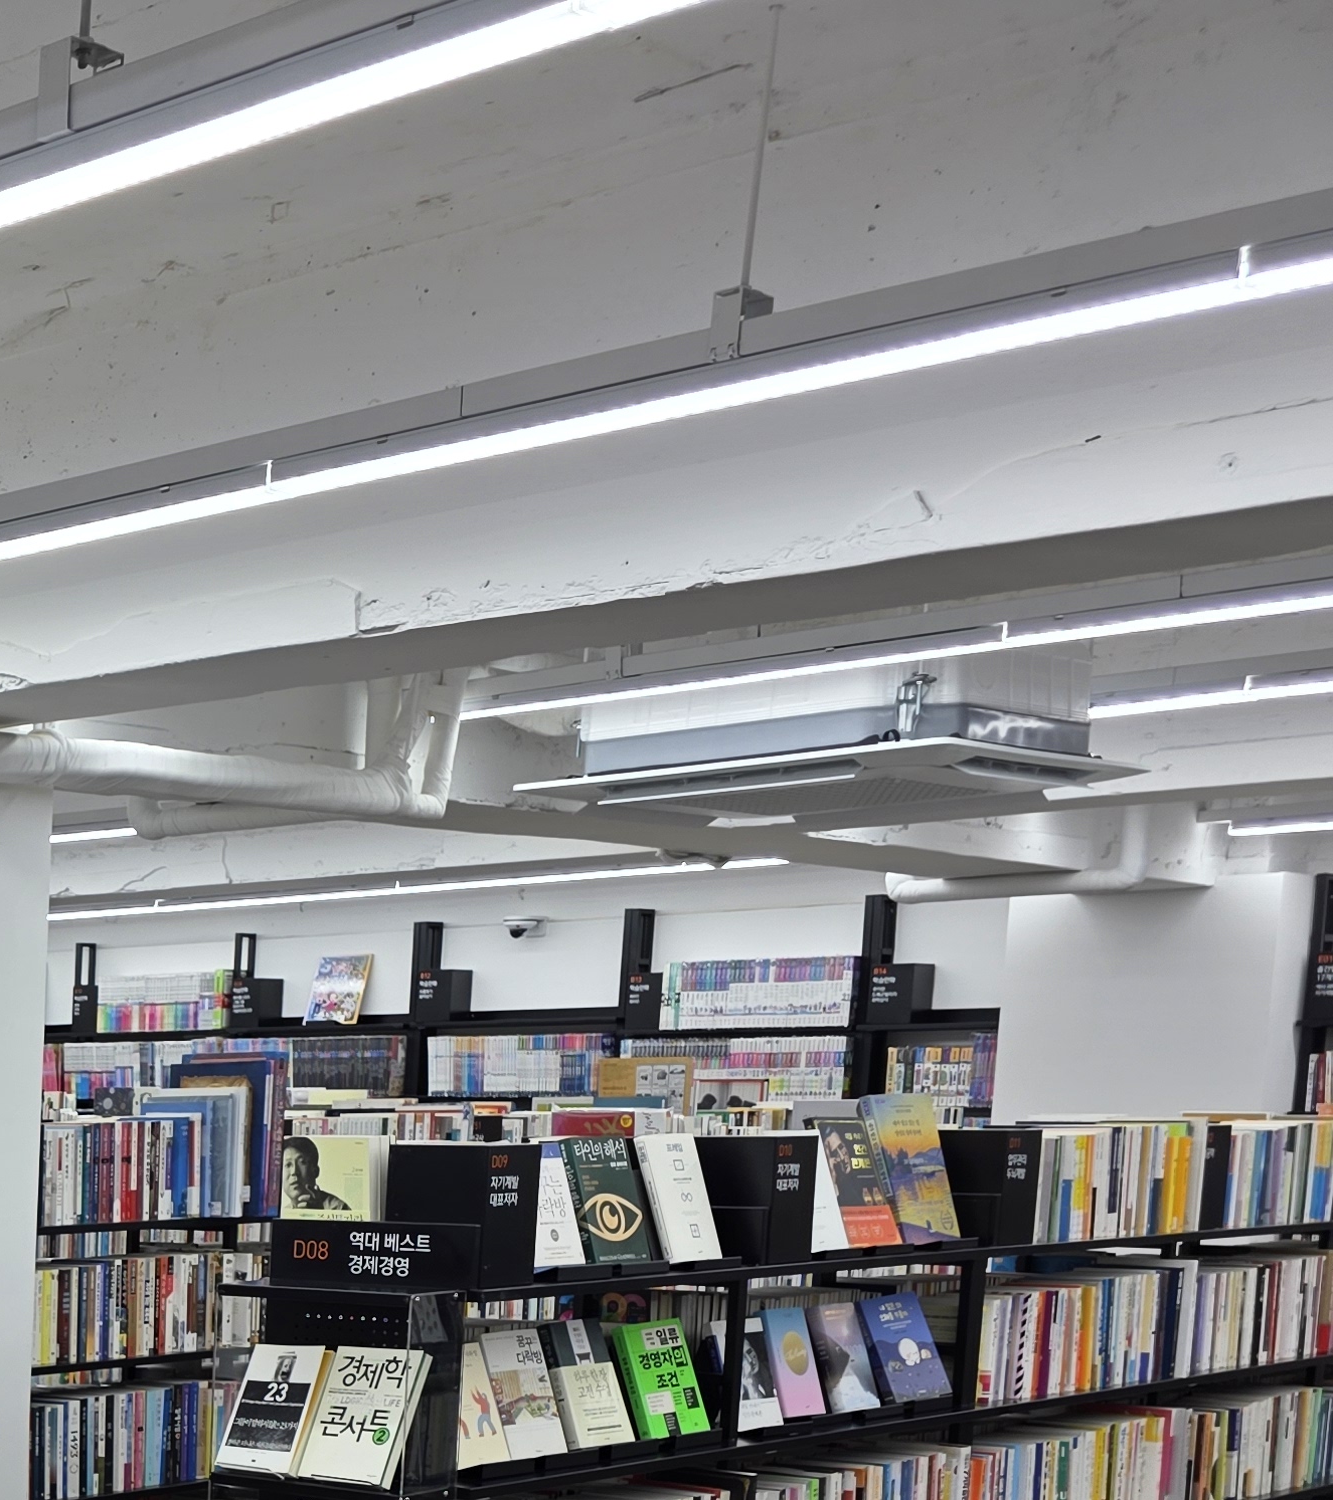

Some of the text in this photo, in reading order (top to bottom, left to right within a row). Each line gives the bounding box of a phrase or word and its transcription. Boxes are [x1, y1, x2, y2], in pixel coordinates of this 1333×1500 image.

[573, 1137, 627, 1161] 타인의 해석
[491, 1154, 509, 1168] D09
[490, 1175, 520, 1190] 자기계발
[489, 1192, 519, 1207] 대표저자
[293, 1239, 329, 1260] D08
[349, 1231, 432, 1253] 역대 베스트
[348, 1255, 410, 1277] 경제경영
[655, 1328, 680, 1345] 일류
[516, 1349, 544, 1365] 다락방
[639, 1344, 688, 1370] 경영자의
[338, 1353, 413, 1390] 경제학
[656, 1371, 680, 1389] 조건
[263, 1383, 289, 1402] 23
[320, 1406, 391, 1442] 콘서트
[375, 1429, 387, 1442] 2
